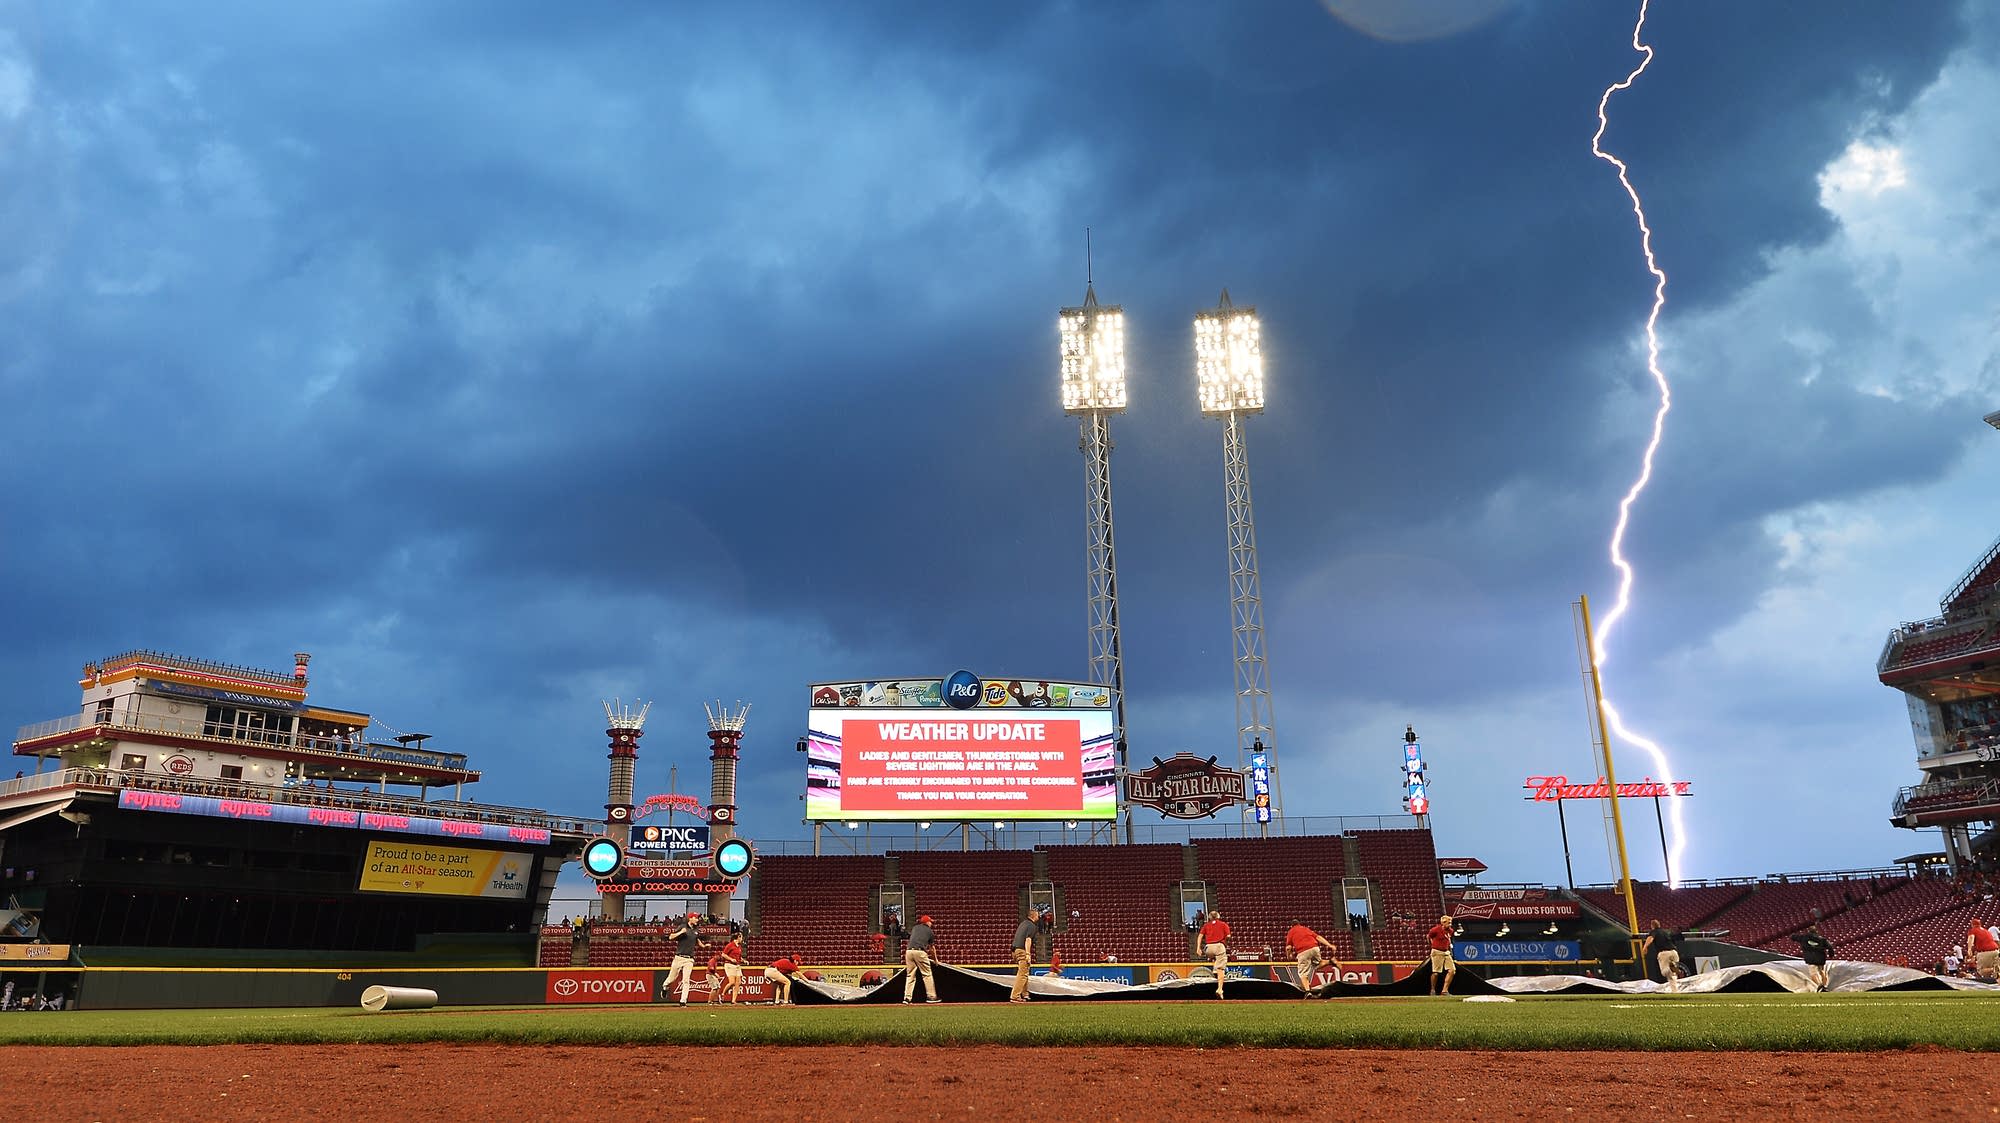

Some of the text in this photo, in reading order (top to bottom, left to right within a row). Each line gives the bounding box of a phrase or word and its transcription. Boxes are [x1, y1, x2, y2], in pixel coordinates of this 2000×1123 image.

[951, 684, 978, 697] P&G
[985, 687, 1006, 701] Tide
[225, 691, 255, 702] PILOT
[256, 695, 293, 708] HOUSE
[920, 695, 941, 703] Pampers
[878, 723, 1045, 740] WEATHER UPDATE
[370, 747, 438, 765] Cincinnati
[860, 752, 1064, 761] LADIES AND GENTLEMEN, THUNDERSTORMS WITH
[170, 762, 193, 771] REDS
[886, 762, 1038, 770] SEVERE LIGHTNING ARE IN THE AREA.
[847, 777, 1077, 785] FANS ARE STRONGLY ENCOURAGED TO MOVE TO THE CONCOURSE.
[1167, 770, 1205, 780] CINCINNATI
[1133, 775, 1240, 798] ALL STAR GAME
[124, 791, 183, 809] FUJITEC
[897, 792, 1028, 800] THANK YOU FOR YOUR COOPERATION.
[220, 800, 273, 818] FUJITEC
[309, 809, 356, 825] FUJITEC
[365, 813, 410, 829] FUJITEC
[441, 820, 484, 836] FUJITEC
[509, 827, 547, 841] FUJITEC
[661, 828, 697, 842] PNC
[634, 841, 705, 849] POWER STACKS
[374, 847, 408, 860] Proud
[411, 852, 422, 861] to
[424, 851, 437, 862] be
[447, 854, 470, 865] part
[371, 862, 475, 879] of an All-Star season.
[656, 868, 697, 877] TOYOTA
[492, 880, 524, 891] TriHealth
[1474, 891, 1502, 899] BOWTIE
[1504, 890, 1519, 899] BAR
[1457, 906, 1492, 915] Budweiser
[1499, 906, 1574, 915] THIS BUD'S FOR YOU.
[1484, 943, 1546, 954] POMEROY
[337, 973, 351, 981] 404
[581, 980, 646, 993] TOYOTA
[745, 986, 763, 995] YOU.
